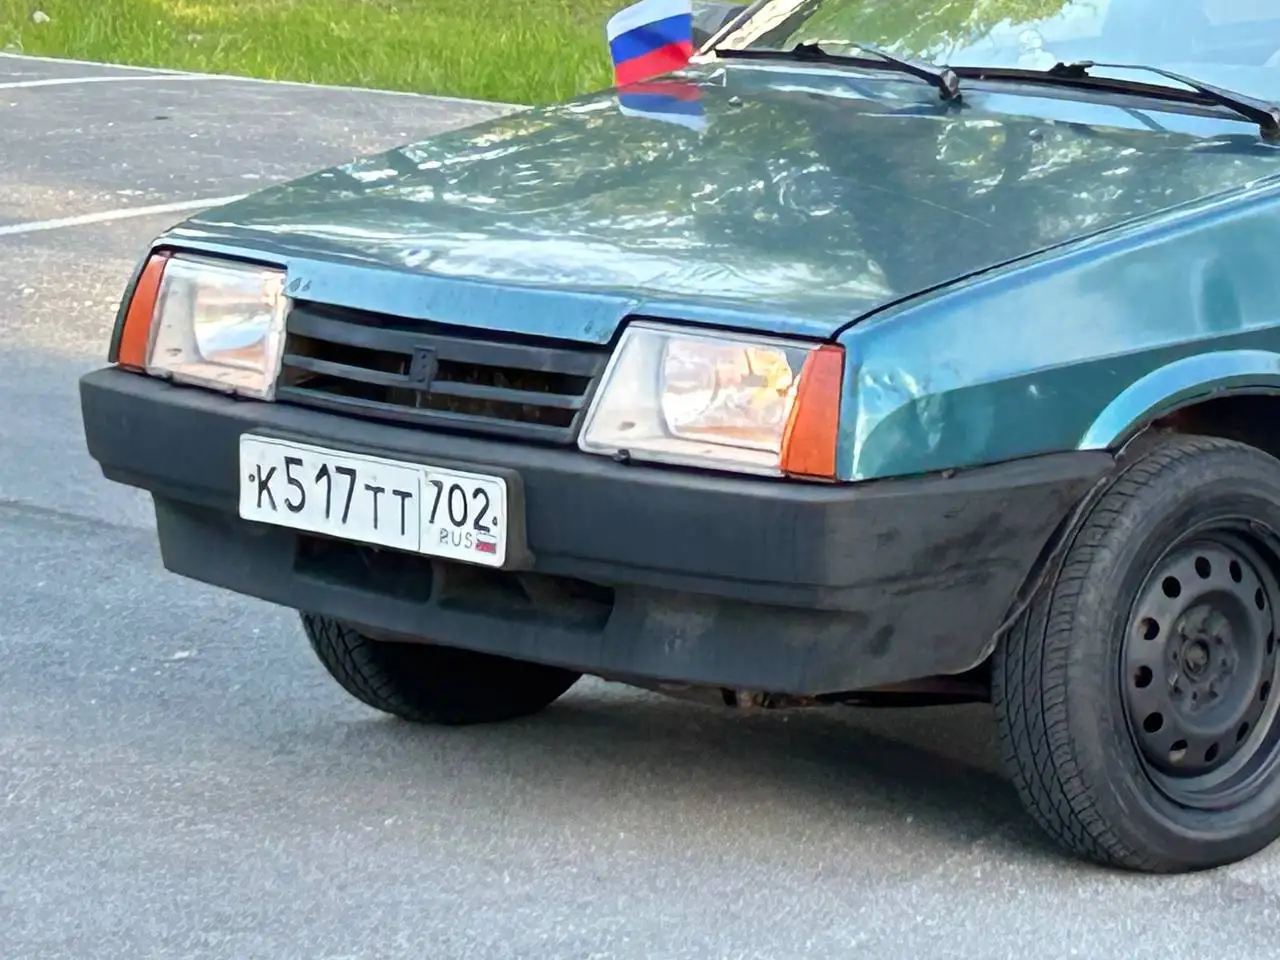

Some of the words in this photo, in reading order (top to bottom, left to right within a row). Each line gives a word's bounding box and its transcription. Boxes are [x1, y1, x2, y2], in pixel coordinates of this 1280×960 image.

[257, 456, 412, 536] K517TT
[428, 480, 490, 533] 702
[439, 528, 473, 549] RUS
